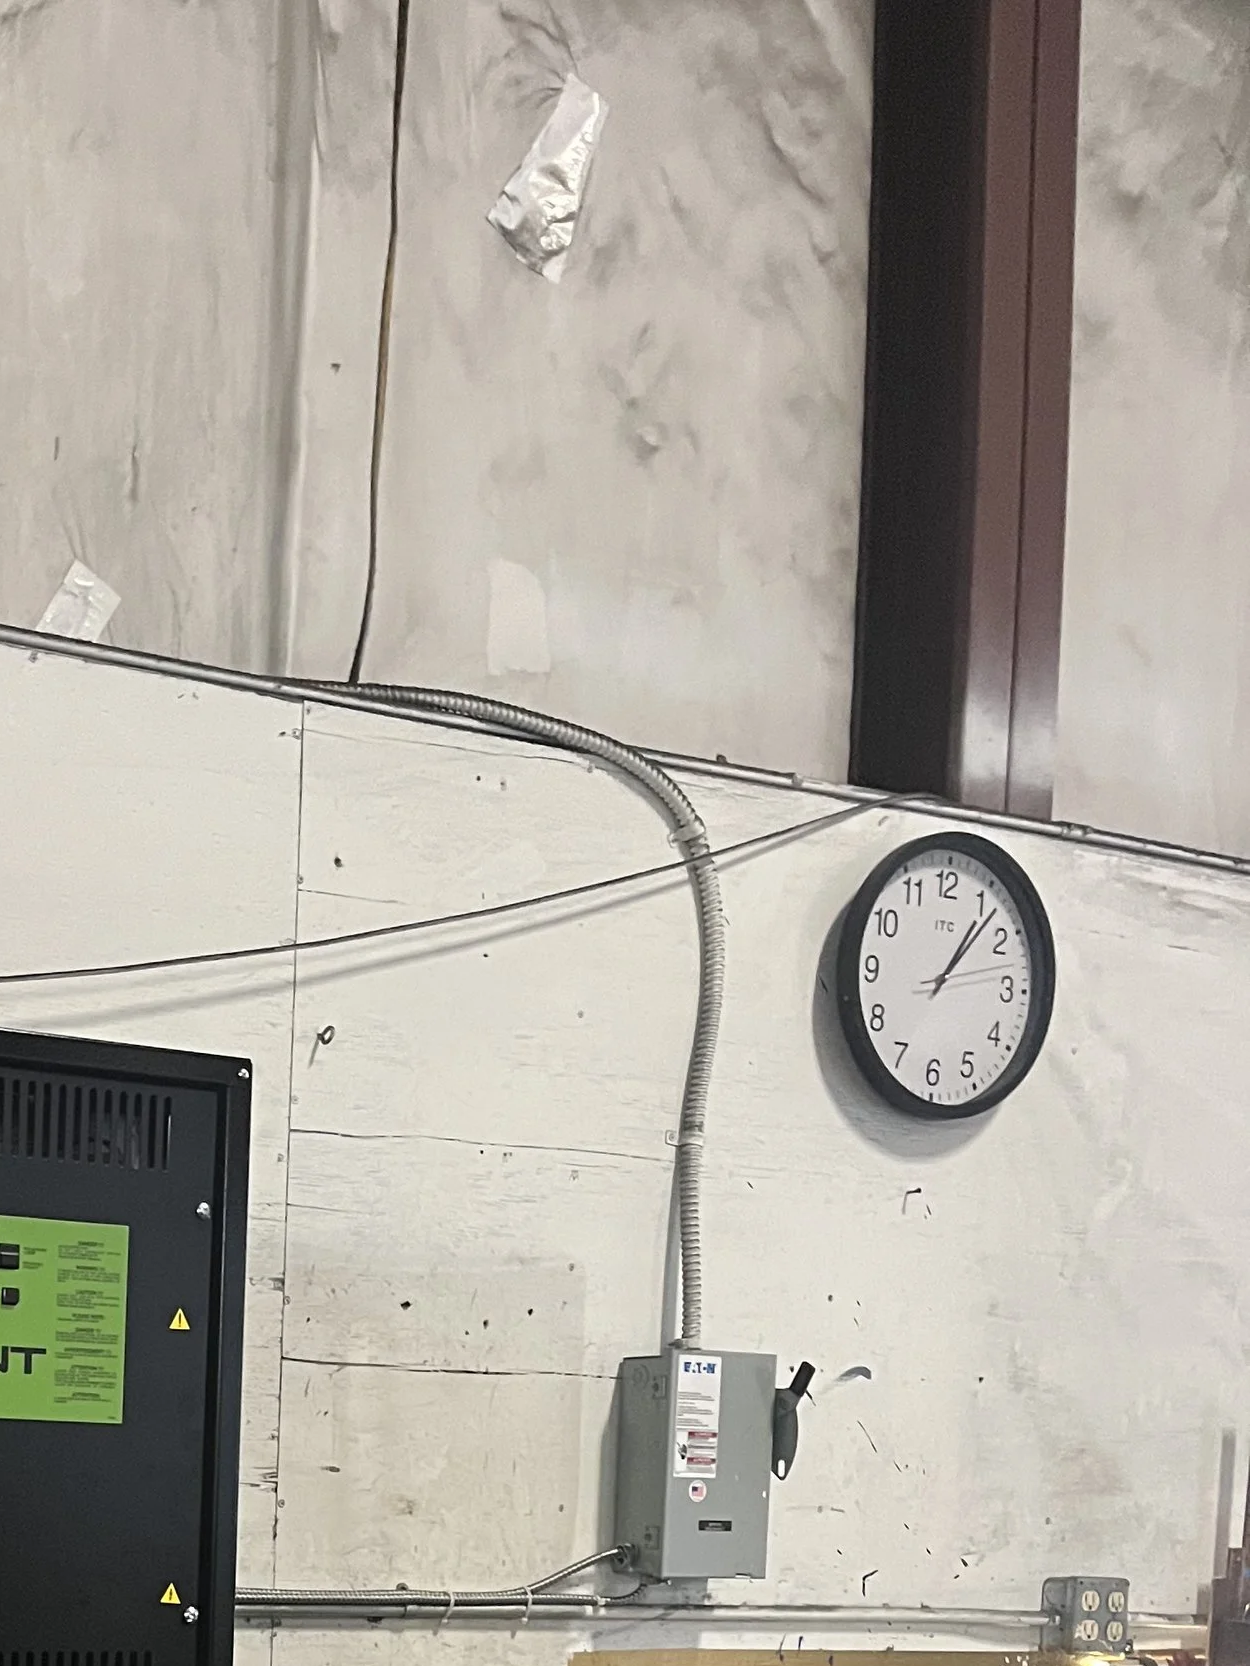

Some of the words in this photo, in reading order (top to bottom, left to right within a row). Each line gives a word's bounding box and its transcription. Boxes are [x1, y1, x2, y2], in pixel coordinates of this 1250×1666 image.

[903, 877, 923, 907] 11
[936, 870, 959, 900] 12
[976, 890, 985, 917] 1
[874, 909, 898, 938] 10
[934, 919, 955, 933] ITC
[993, 928, 1007, 955] 2
[865, 955, 879, 983] 9
[999, 976, 1014, 1003] 3
[870, 1004, 885, 1031] 8
[987, 1021, 1000, 1047] 4
[894, 1041, 908, 1069] 7
[960, 1051, 975, 1078] 5
[926, 1059, 940, 1086] 6
